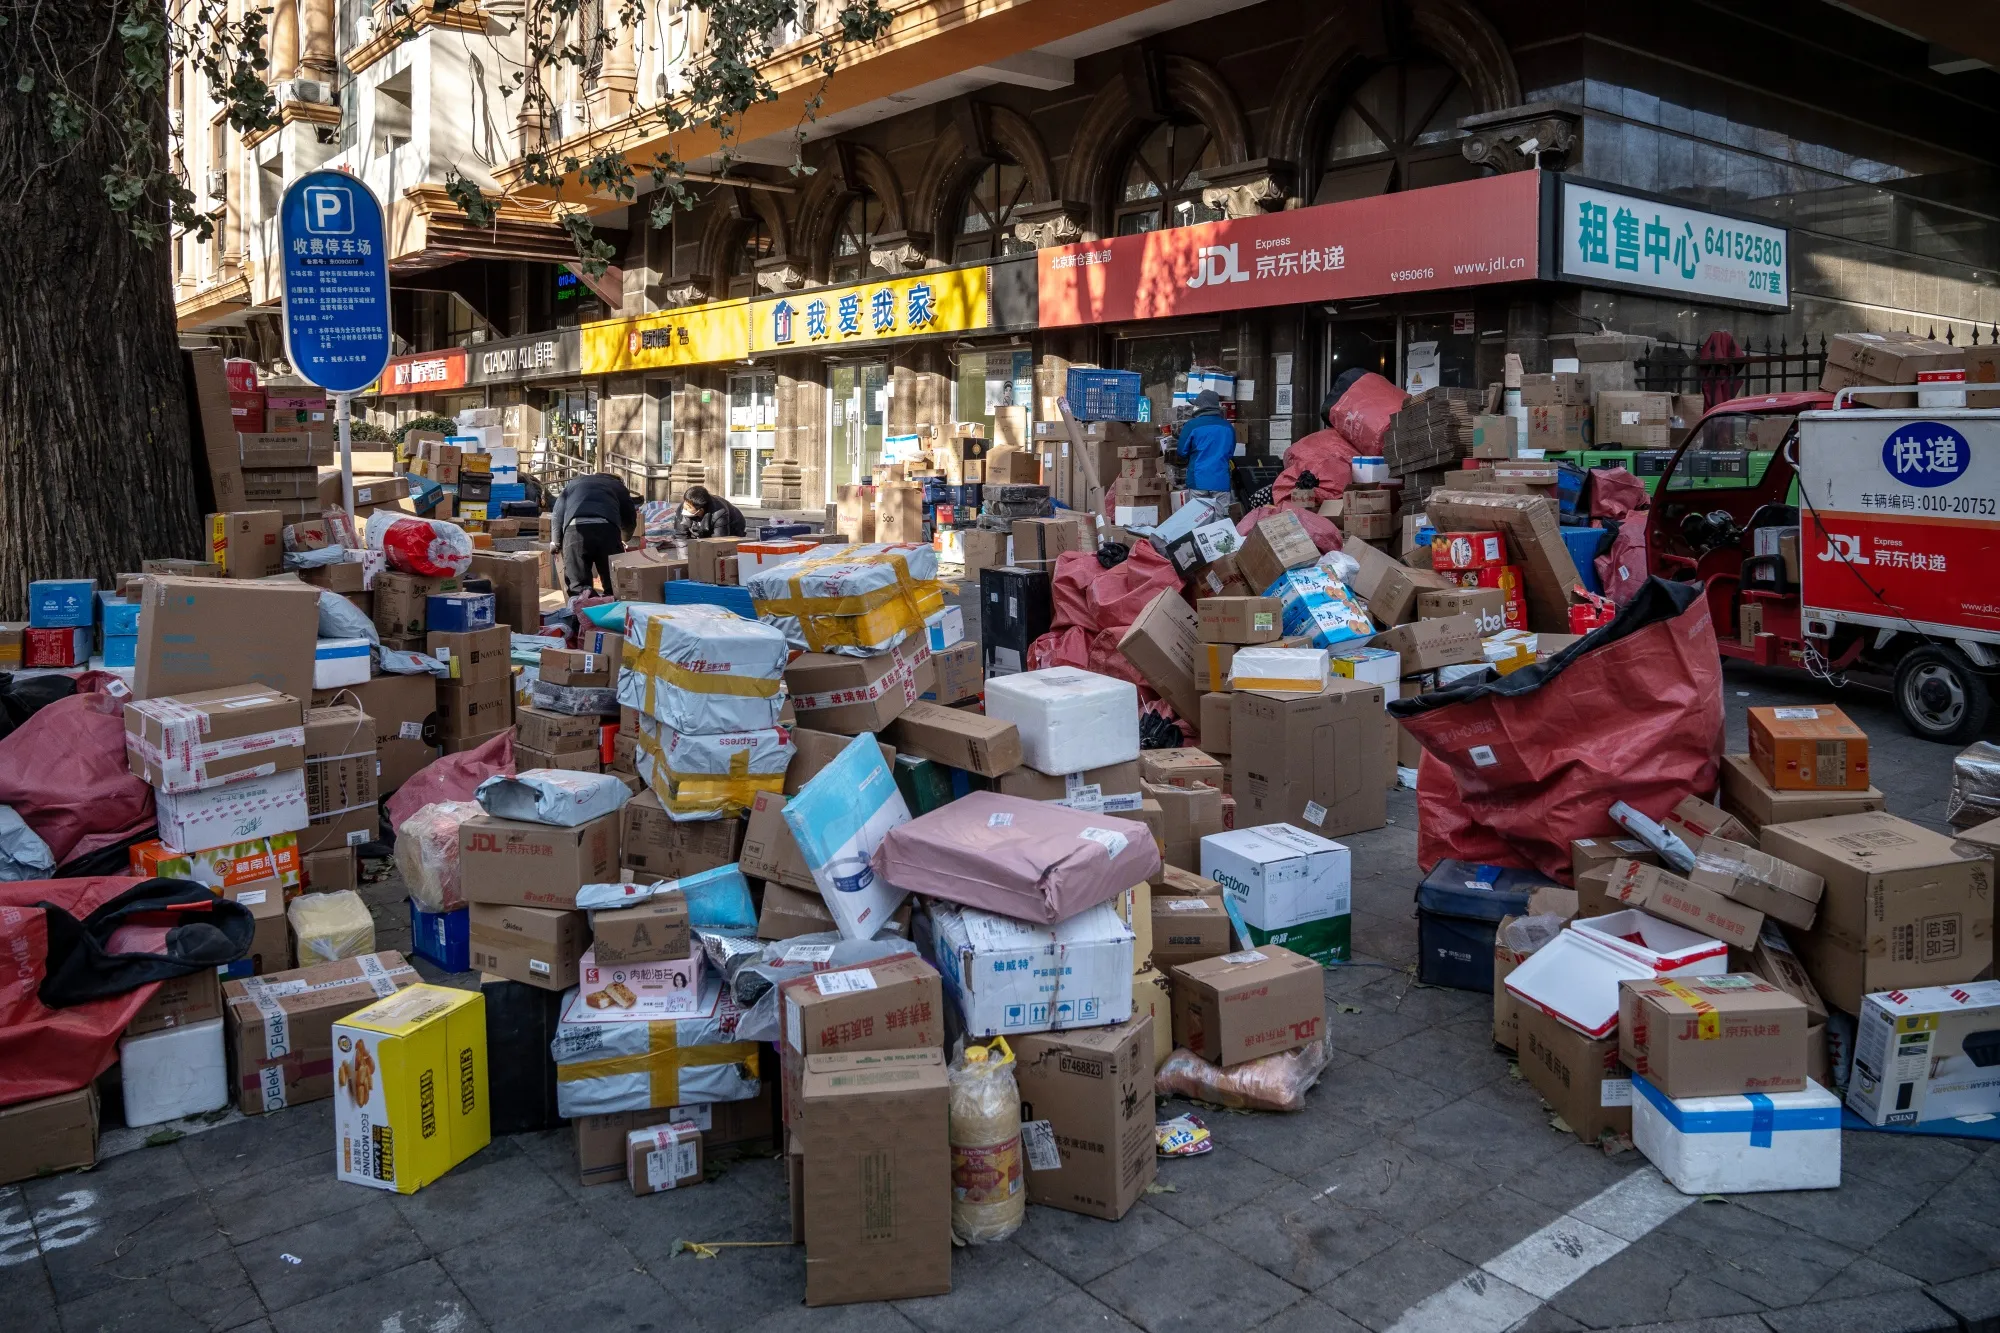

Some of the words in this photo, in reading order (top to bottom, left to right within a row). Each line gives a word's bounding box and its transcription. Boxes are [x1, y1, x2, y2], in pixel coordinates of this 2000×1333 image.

[316, 193, 341, 227] P
[293, 238, 372, 255] 收费停车场
[1255, 235, 1291, 250] Express
[1578, 200, 1700, 280] 租售中心
[1704, 226, 1782, 267] 64152580
[1052, 250, 1112, 270] 北京新仓营业部
[1186, 242, 1250, 289] JDL
[1255, 244, 1346, 279] 京东快递
[1453, 255, 1526, 277] www.jdl.cn
[1398, 266, 1434, 282] 950616
[1748, 270, 1782, 294] 207室
[806, 281, 936, 337] 我爱我家
[1893, 436, 1959, 474] 快递
[1817, 534, 1870, 565] JDL
[1874, 538, 1903, 547] Express
[1874, 550, 1947, 572] 京东快递
[480, 647, 505, 660] NAYUKI
[478, 699, 503, 713] NAYUKI
[831, 686, 879, 704] 玻璃制品
[720, 738, 758, 747] Express
[466, 833, 503, 853] JDL
[505, 843, 553, 856] 京东快递
[632, 923, 652, 947] A
[1925, 920, 1939, 957] 纯品
[1942, 920, 1957, 955] 原木
[630, 968, 674, 981] 肉松海苔
[886, 1001, 933, 1030] 营养美味
[1084, 1001, 1093, 1011] 6
[823, 1015, 875, 1047] 品质生活
[1245, 1027, 1287, 1047] 京东快递
[1288, 1016, 1320, 1041] JDL
[1724, 1024, 1781, 1038] 京东快递
[361, 1113, 370, 1134] EGG
[1890, 1113, 1914, 1123] INTEX
[361, 1134, 371, 1177] MODING
